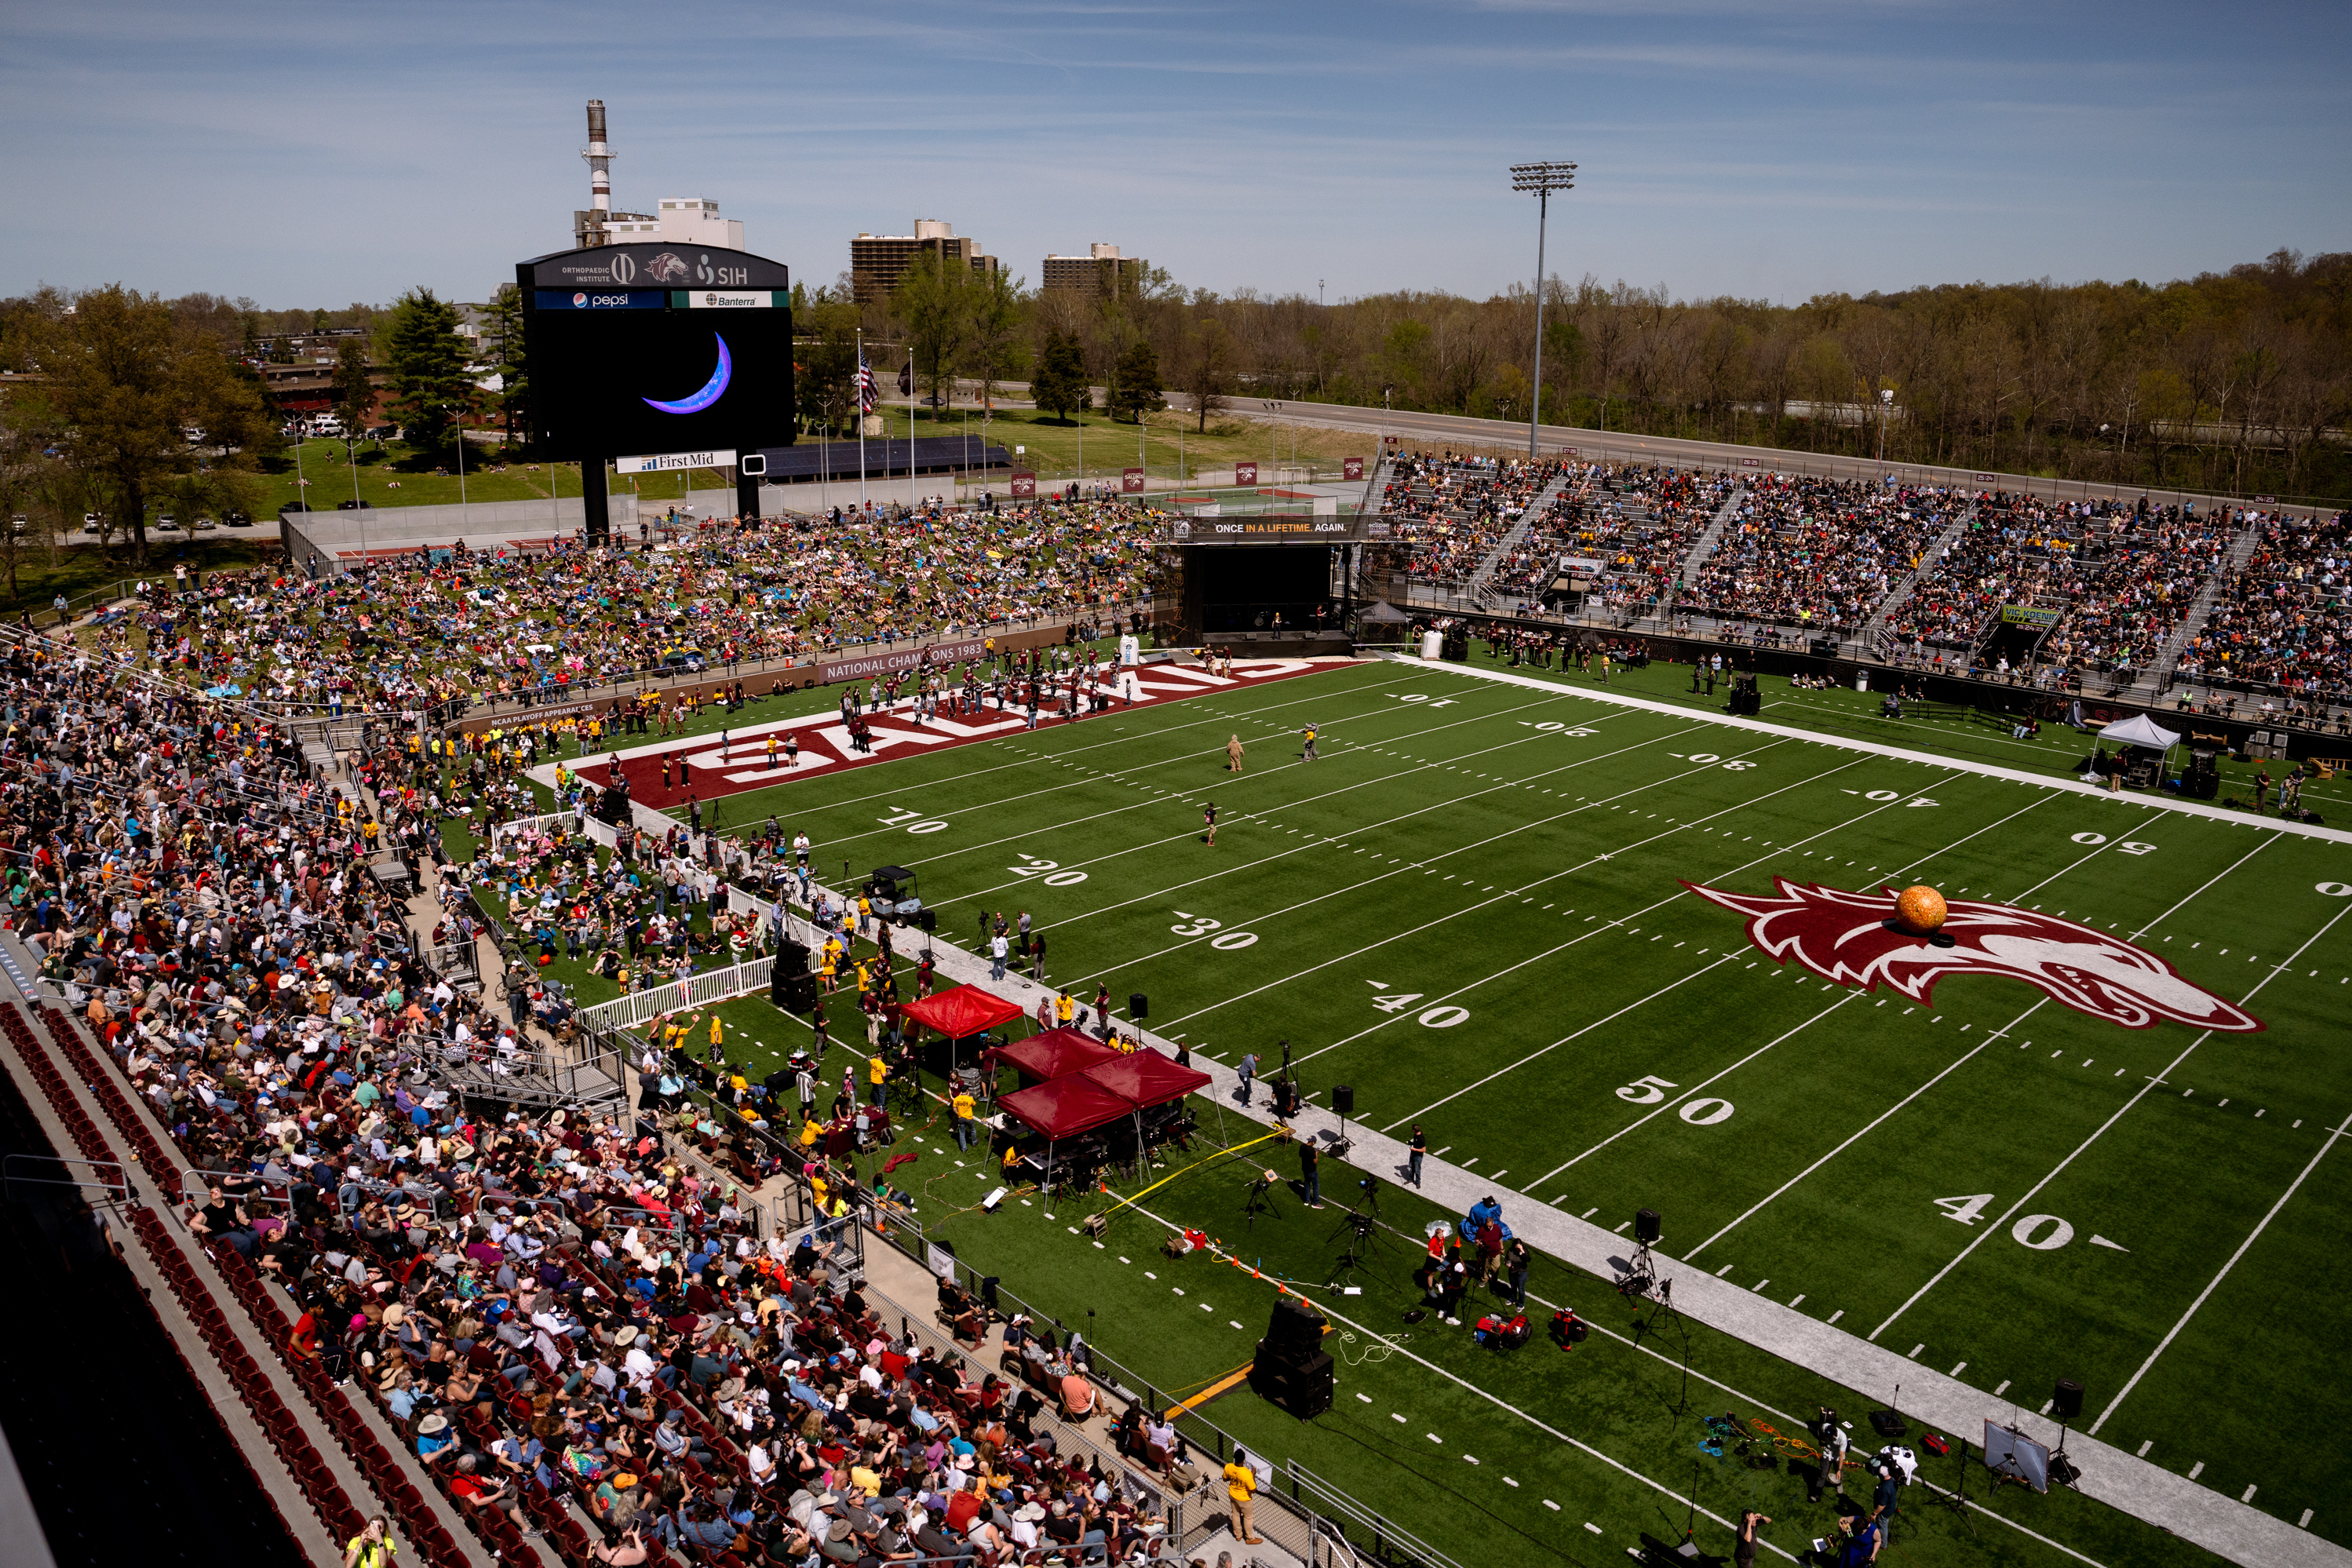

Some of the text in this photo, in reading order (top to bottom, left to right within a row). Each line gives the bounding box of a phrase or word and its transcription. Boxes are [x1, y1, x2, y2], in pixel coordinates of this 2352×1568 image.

[718, 268, 747, 285] SIH
[593, 294, 628, 307] pepsi
[718, 297, 756, 307] Banterra
[658, 453, 714, 468] First Mid
[1216, 524, 1244, 533] ONCE
[1267, 523, 1313, 532] LIFETIME.
[1315, 523, 1347, 532] AGAIN.
[2006, 607, 2020, 616] VIC
[827, 644, 981, 678] NATIONAL CHAMONS 1983
[1400, 694, 1460, 708] 10
[491, 717, 512, 726] NCAA
[512, 713, 543, 723] PLAYOFF
[1533, 721, 1602, 738] 20
[1688, 753, 1758, 771] 30
[1865, 789, 1941, 808] 40
[877, 811, 948, 833] 10
[2070, 832, 2158, 856] 50
[1007, 859, 1088, 887] 20
[1170, 917, 1259, 950] 30
[1371, 993, 1470, 1028] 40
[1615, 1074, 1734, 1125] 50
[1933, 1193, 2074, 1250] 40
